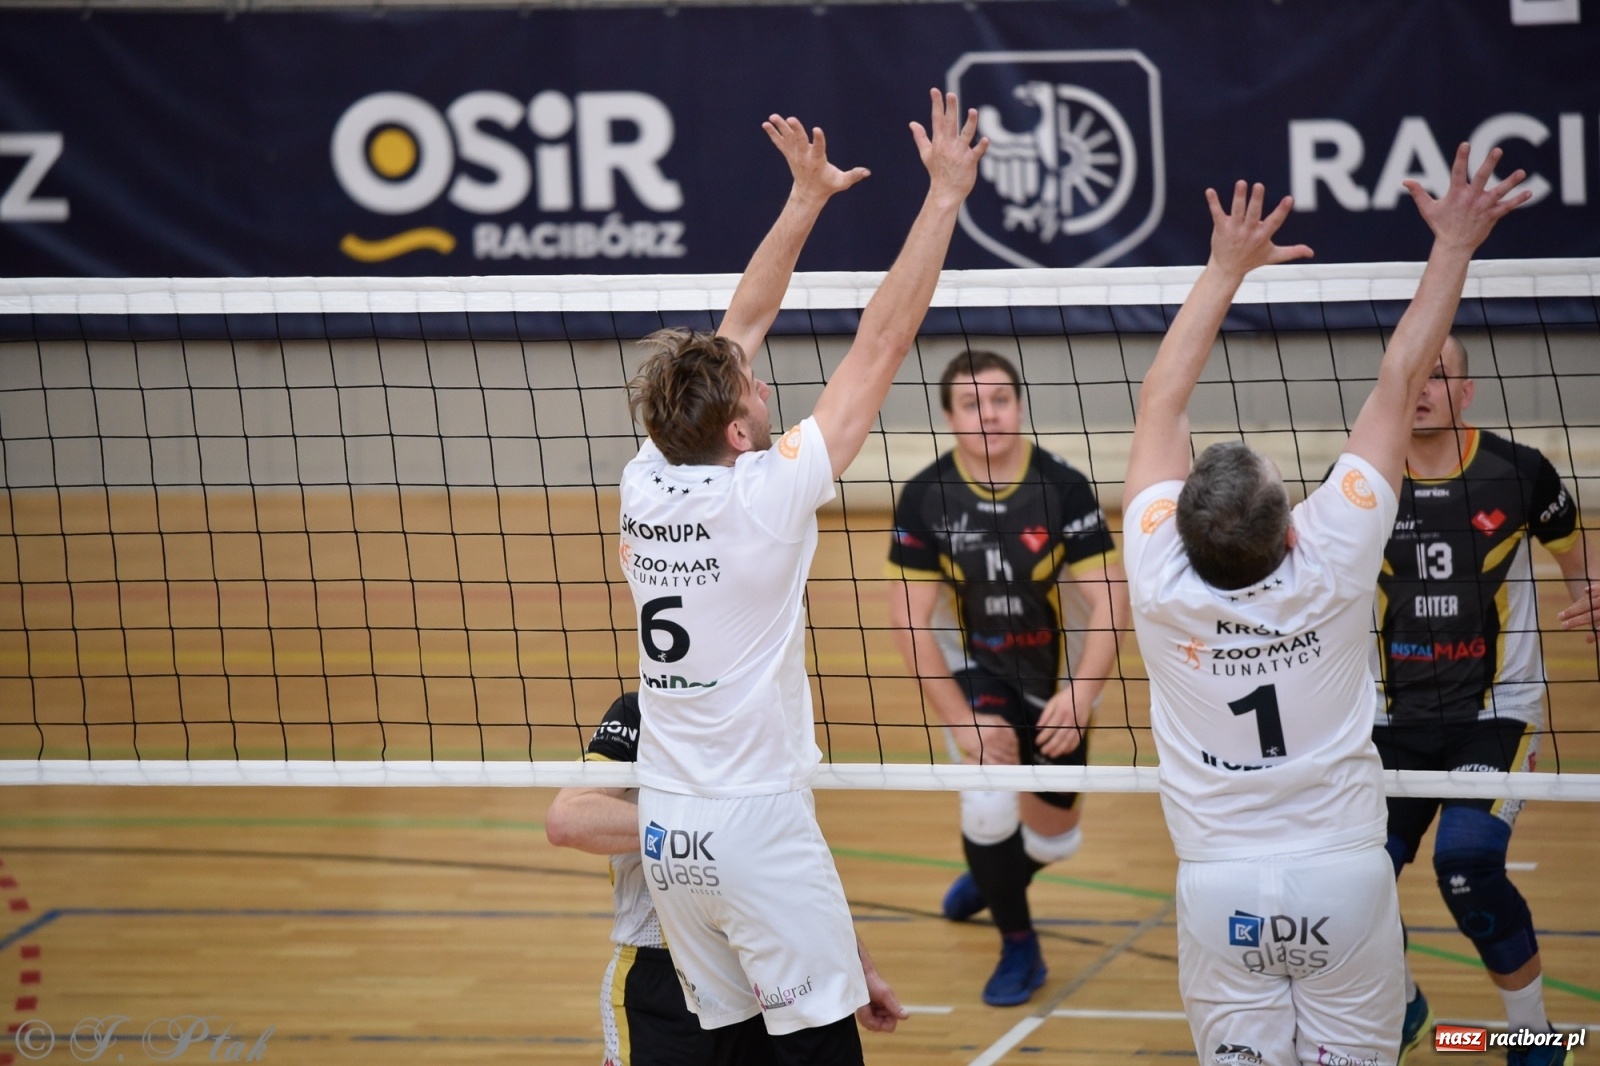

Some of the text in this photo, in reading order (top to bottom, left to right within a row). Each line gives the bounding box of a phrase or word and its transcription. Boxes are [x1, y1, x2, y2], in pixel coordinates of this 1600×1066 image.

[331, 91, 684, 214] OSiR
[475, 213, 686, 260] RACIBÓRZ
[622, 514, 711, 542] SKORUPA
[633, 554, 720, 573] ZOO-MAR
[1416, 542, 1453, 580] 13
[633, 570, 721, 587] LUNATYCY
[641, 595, 690, 663] 6
[1212, 646, 1321, 677] LUNATYCY
[1228, 683, 1287, 758] 1
[670, 830, 715, 861] DK
[651, 856, 719, 891] glass
[1270, 914, 1330, 945] DK
[1242, 942, 1328, 973] glass
[761, 976, 812, 1007] kolgraf
